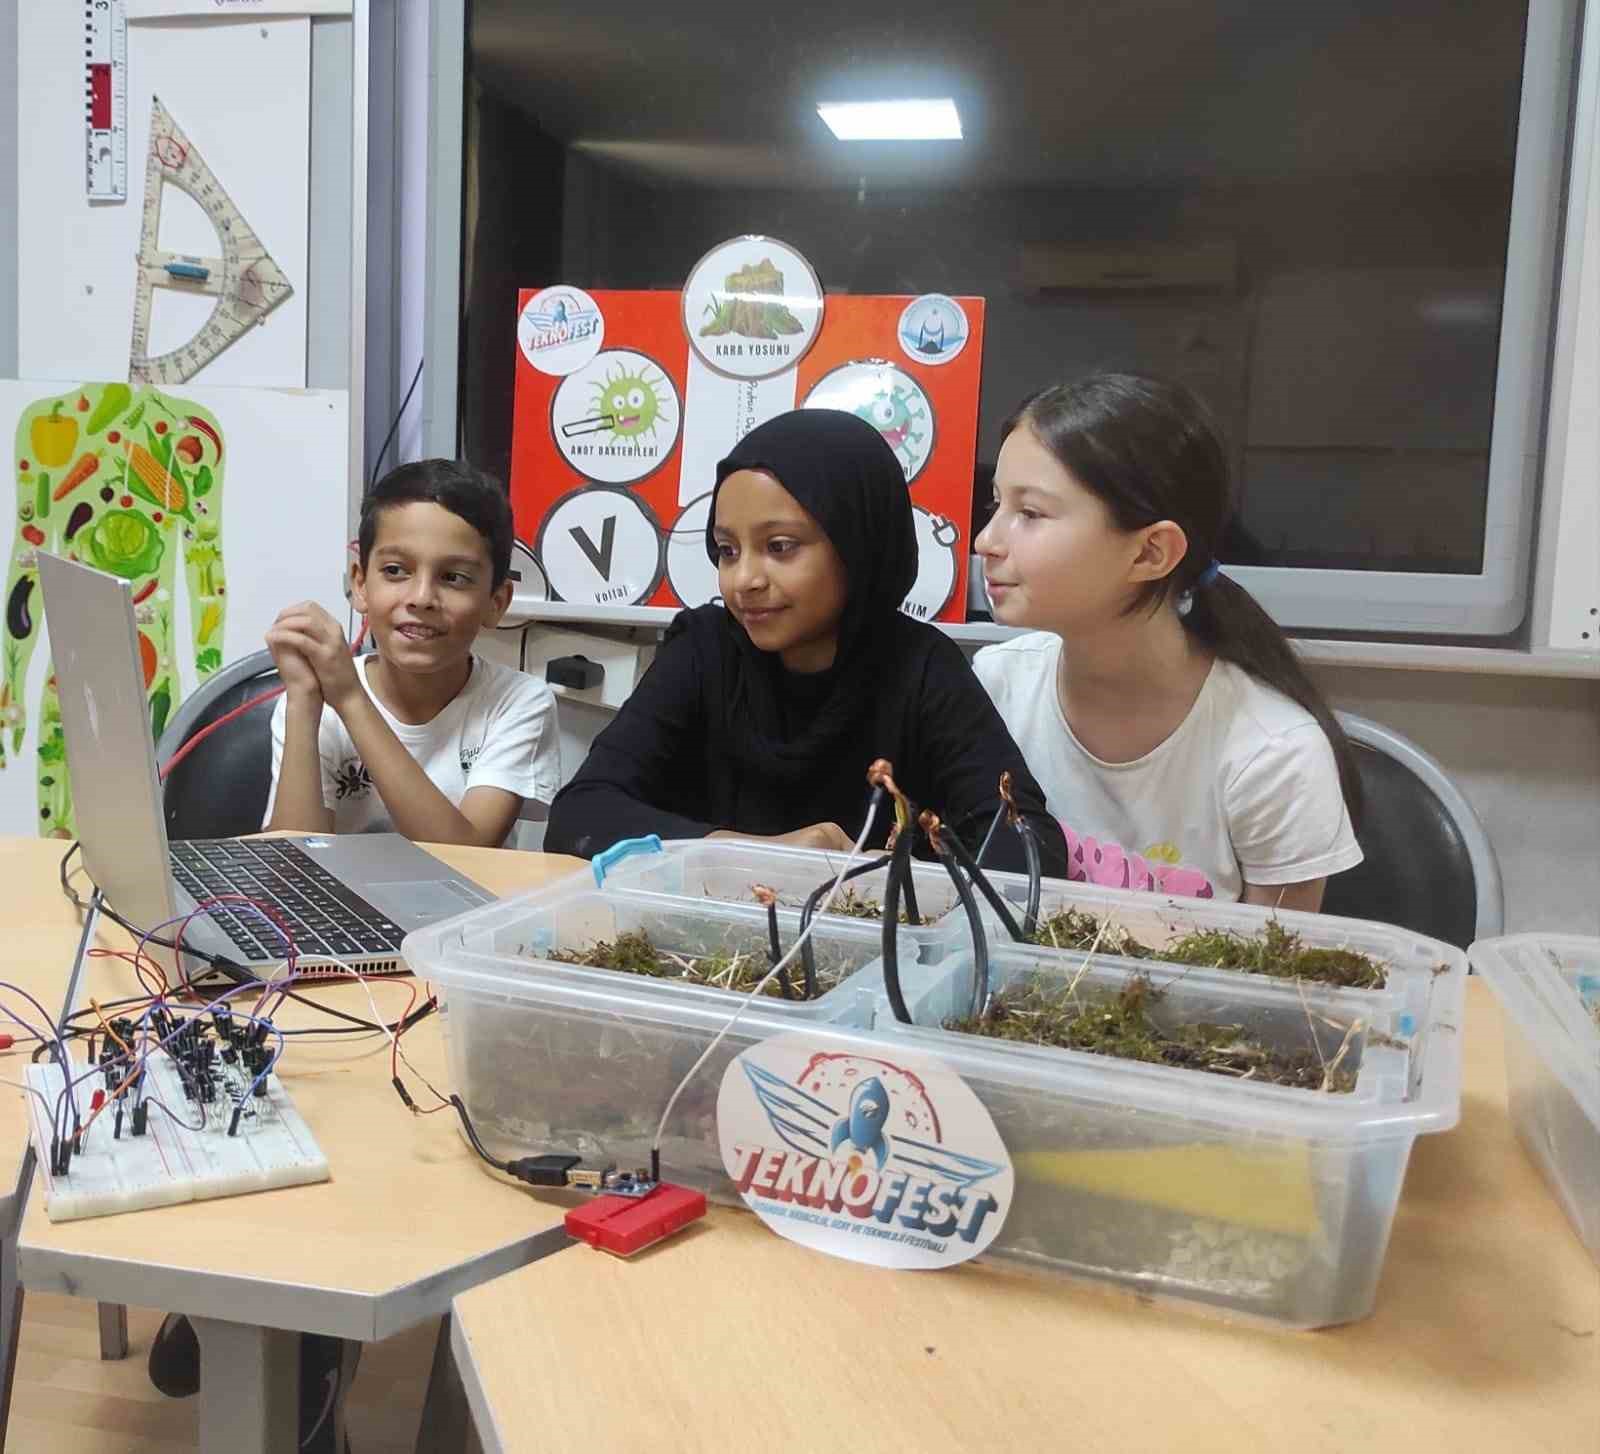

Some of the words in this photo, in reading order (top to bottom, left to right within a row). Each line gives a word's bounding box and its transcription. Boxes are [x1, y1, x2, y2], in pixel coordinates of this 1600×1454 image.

[716, 343, 743, 356] KARA
[749, 343, 790, 356] YOSUNU
[571, 444, 594, 456] ANOT
[567, 515, 617, 583] V
[903, 601, 928, 617] KIM
[734, 1145, 998, 1243] TEKNOFEST
